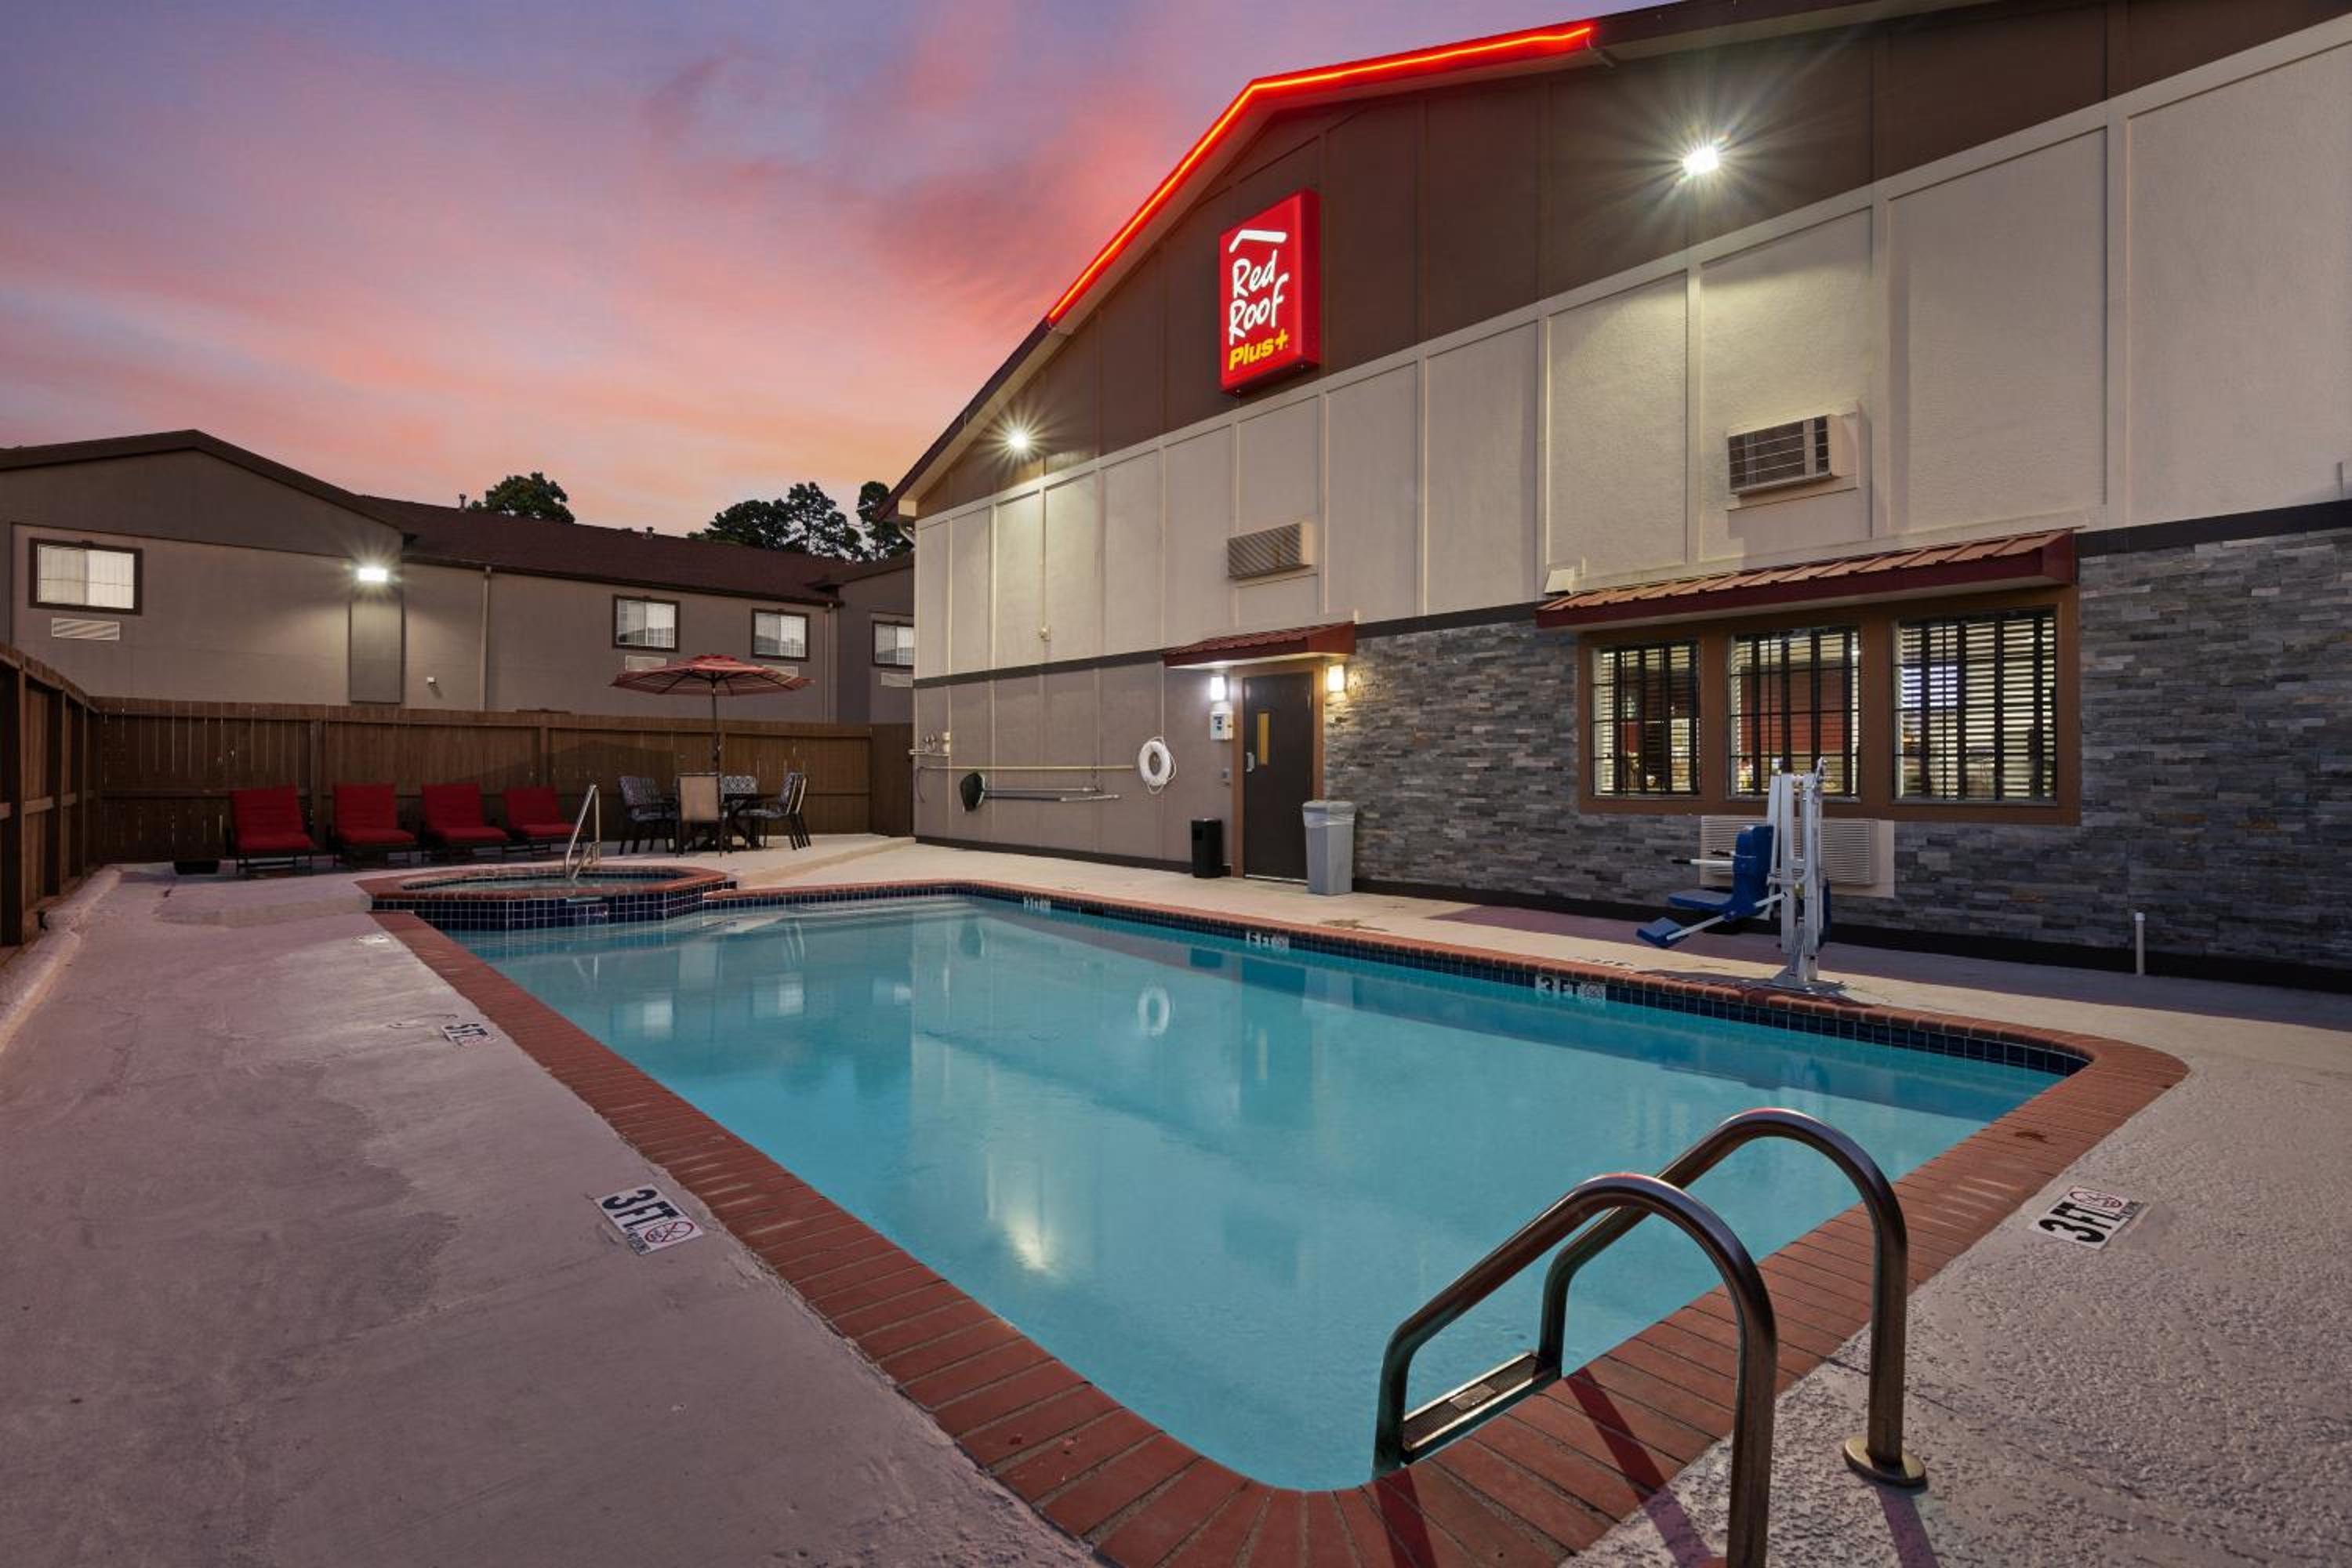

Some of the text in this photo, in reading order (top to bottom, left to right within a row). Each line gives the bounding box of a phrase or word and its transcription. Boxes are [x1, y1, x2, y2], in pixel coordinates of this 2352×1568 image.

[1232, 249, 1277, 298] Red
[1229, 273, 1289, 346] Roof
[1229, 328, 1288, 371] Plus+
